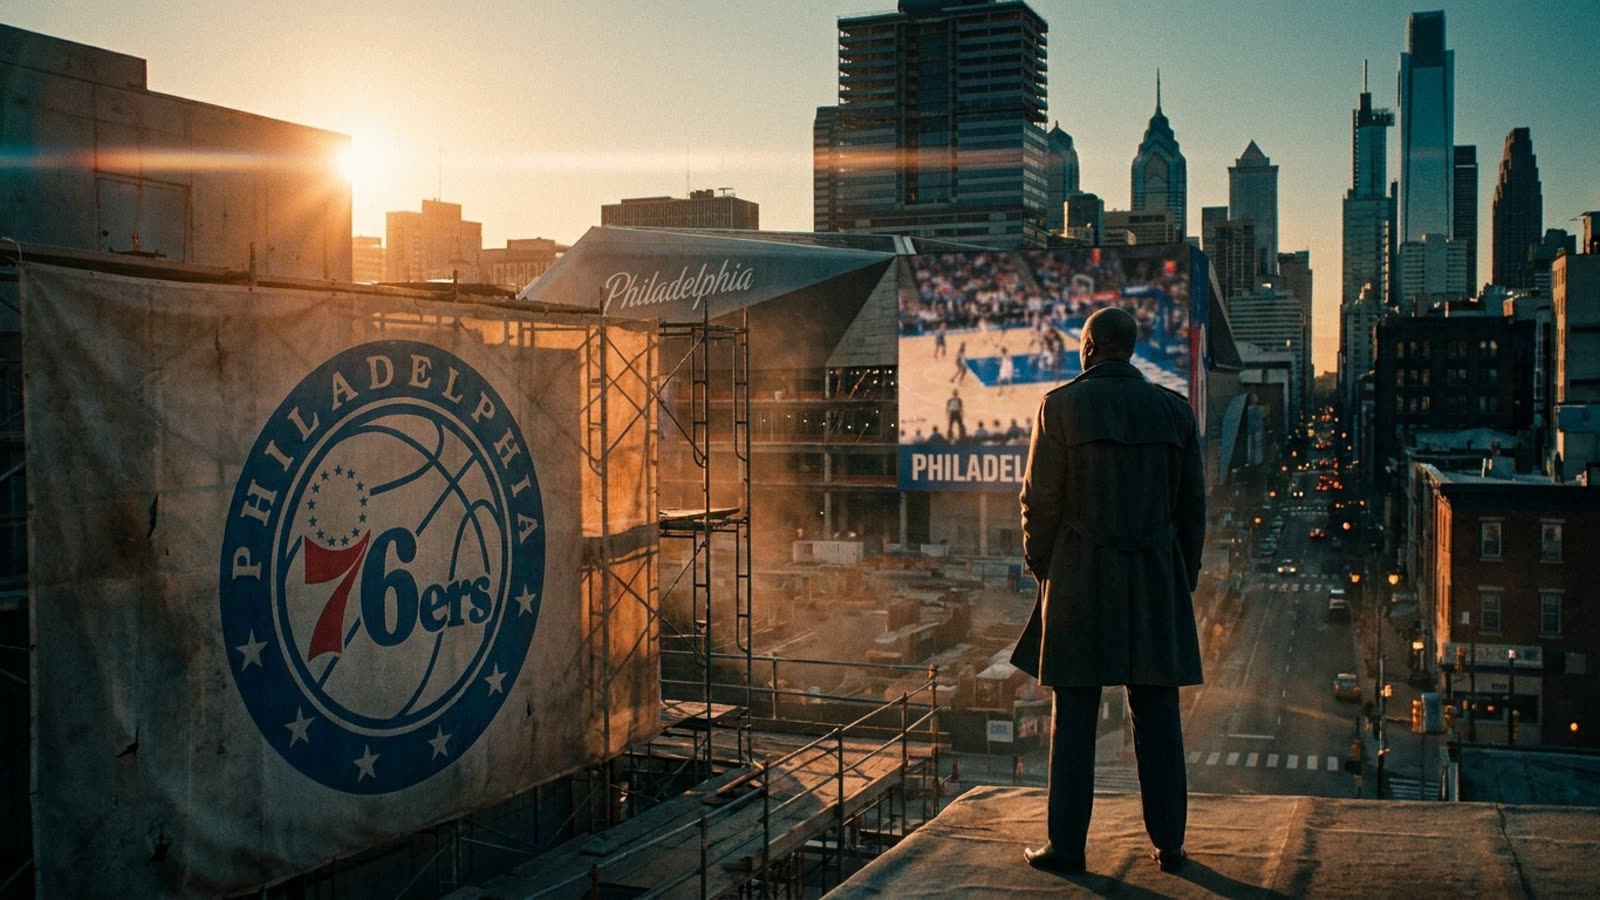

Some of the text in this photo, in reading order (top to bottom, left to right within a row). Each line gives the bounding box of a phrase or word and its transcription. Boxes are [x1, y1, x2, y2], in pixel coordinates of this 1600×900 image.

[603, 259, 753, 315] Philadelphia
[232, 354, 538, 580] PHILADELPHIA
[304, 528, 493, 664] 76ers
